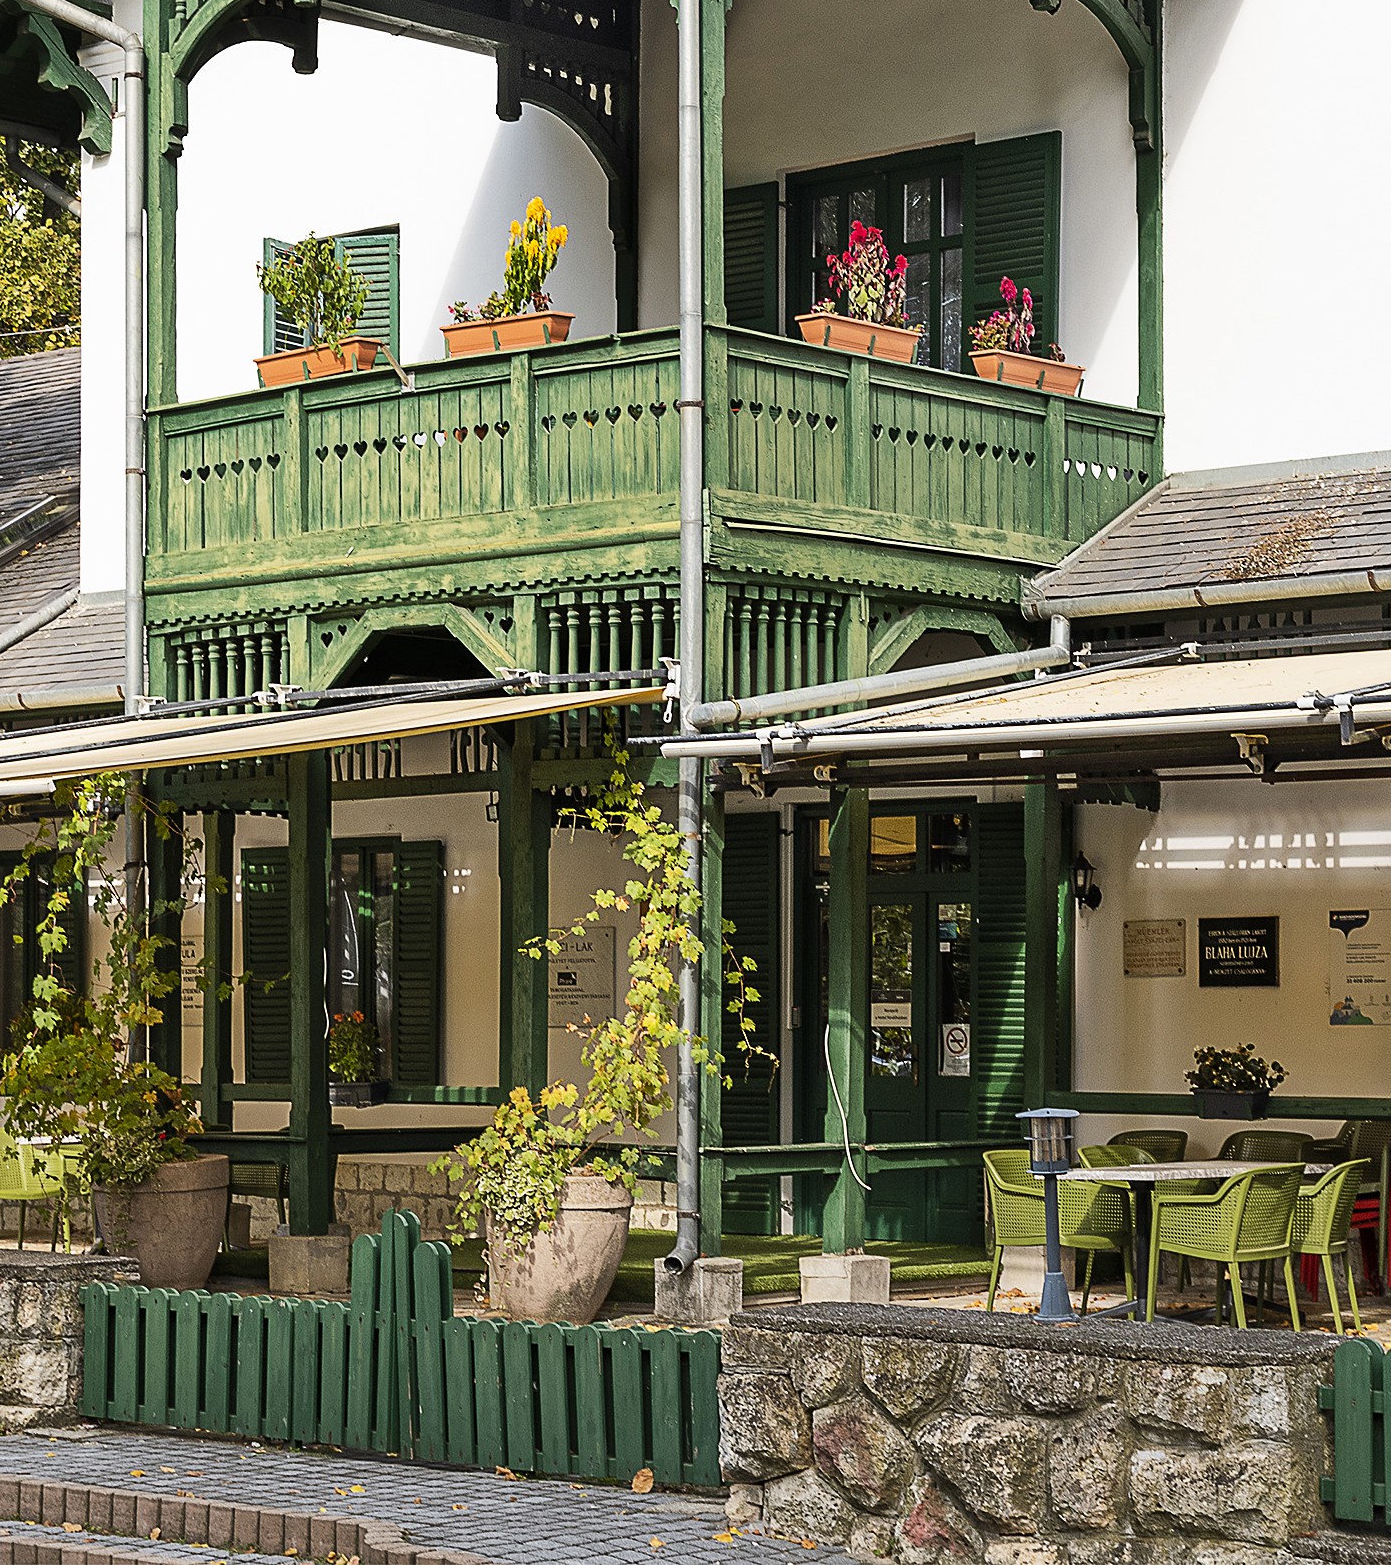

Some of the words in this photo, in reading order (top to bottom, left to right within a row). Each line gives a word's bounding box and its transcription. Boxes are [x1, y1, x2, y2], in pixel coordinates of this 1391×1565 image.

[181, 949, 196, 959] ULA
[1205, 946, 1236, 960] BLAHA
[1238, 945, 1268, 959] LUJZA
